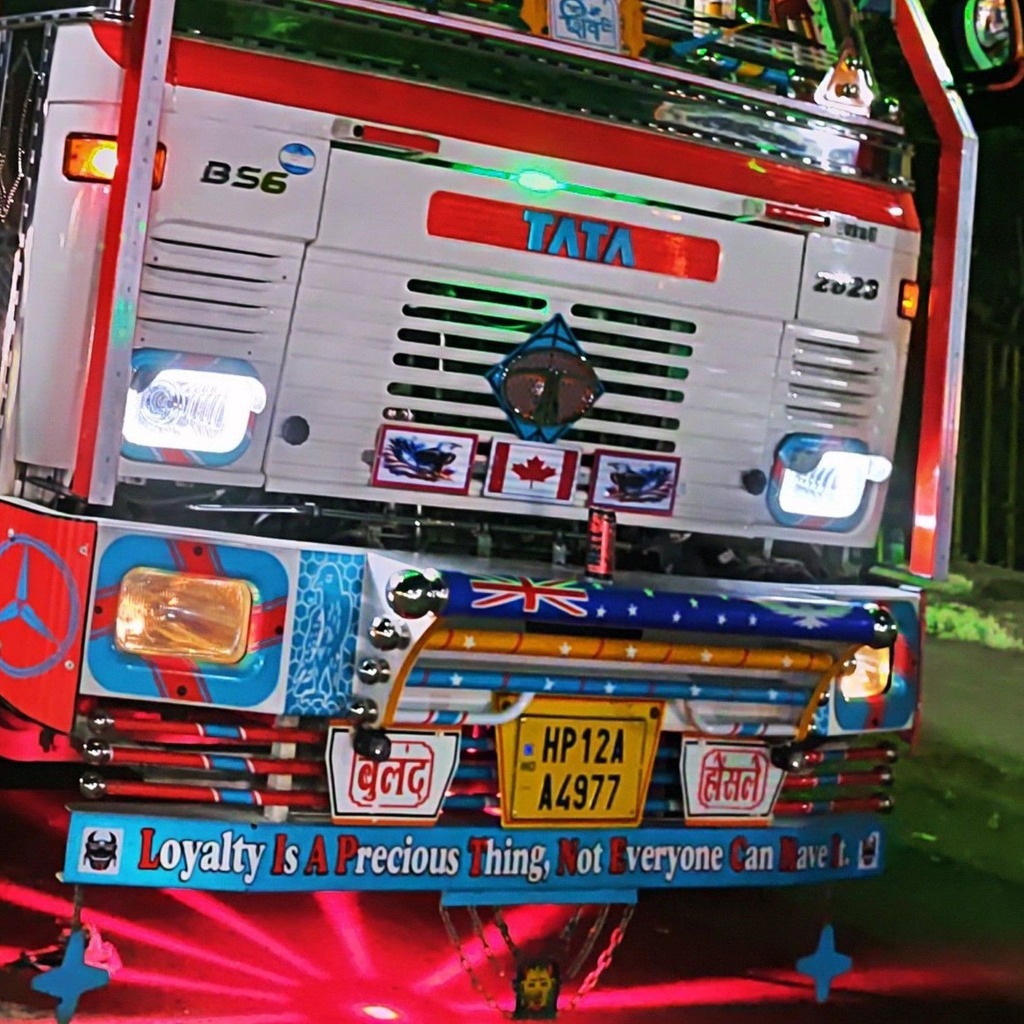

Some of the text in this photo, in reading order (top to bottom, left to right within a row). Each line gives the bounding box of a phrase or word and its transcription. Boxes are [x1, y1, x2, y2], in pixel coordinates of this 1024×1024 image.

[200, 160, 289, 195] BS6
[522, 209, 635, 269] TATA
[538, 773, 622, 811] A4977
[137, 828, 266, 885] Loyalty
[272, 833, 299, 876] Is
[304, 834, 329, 875] A
[334, 834, 461, 876] Precious
[469, 836, 552, 884] Thing,
[556, 837, 604, 876] Not
[608, 836, 724, 882] Everyone
[729, 835, 775, 874] Can
